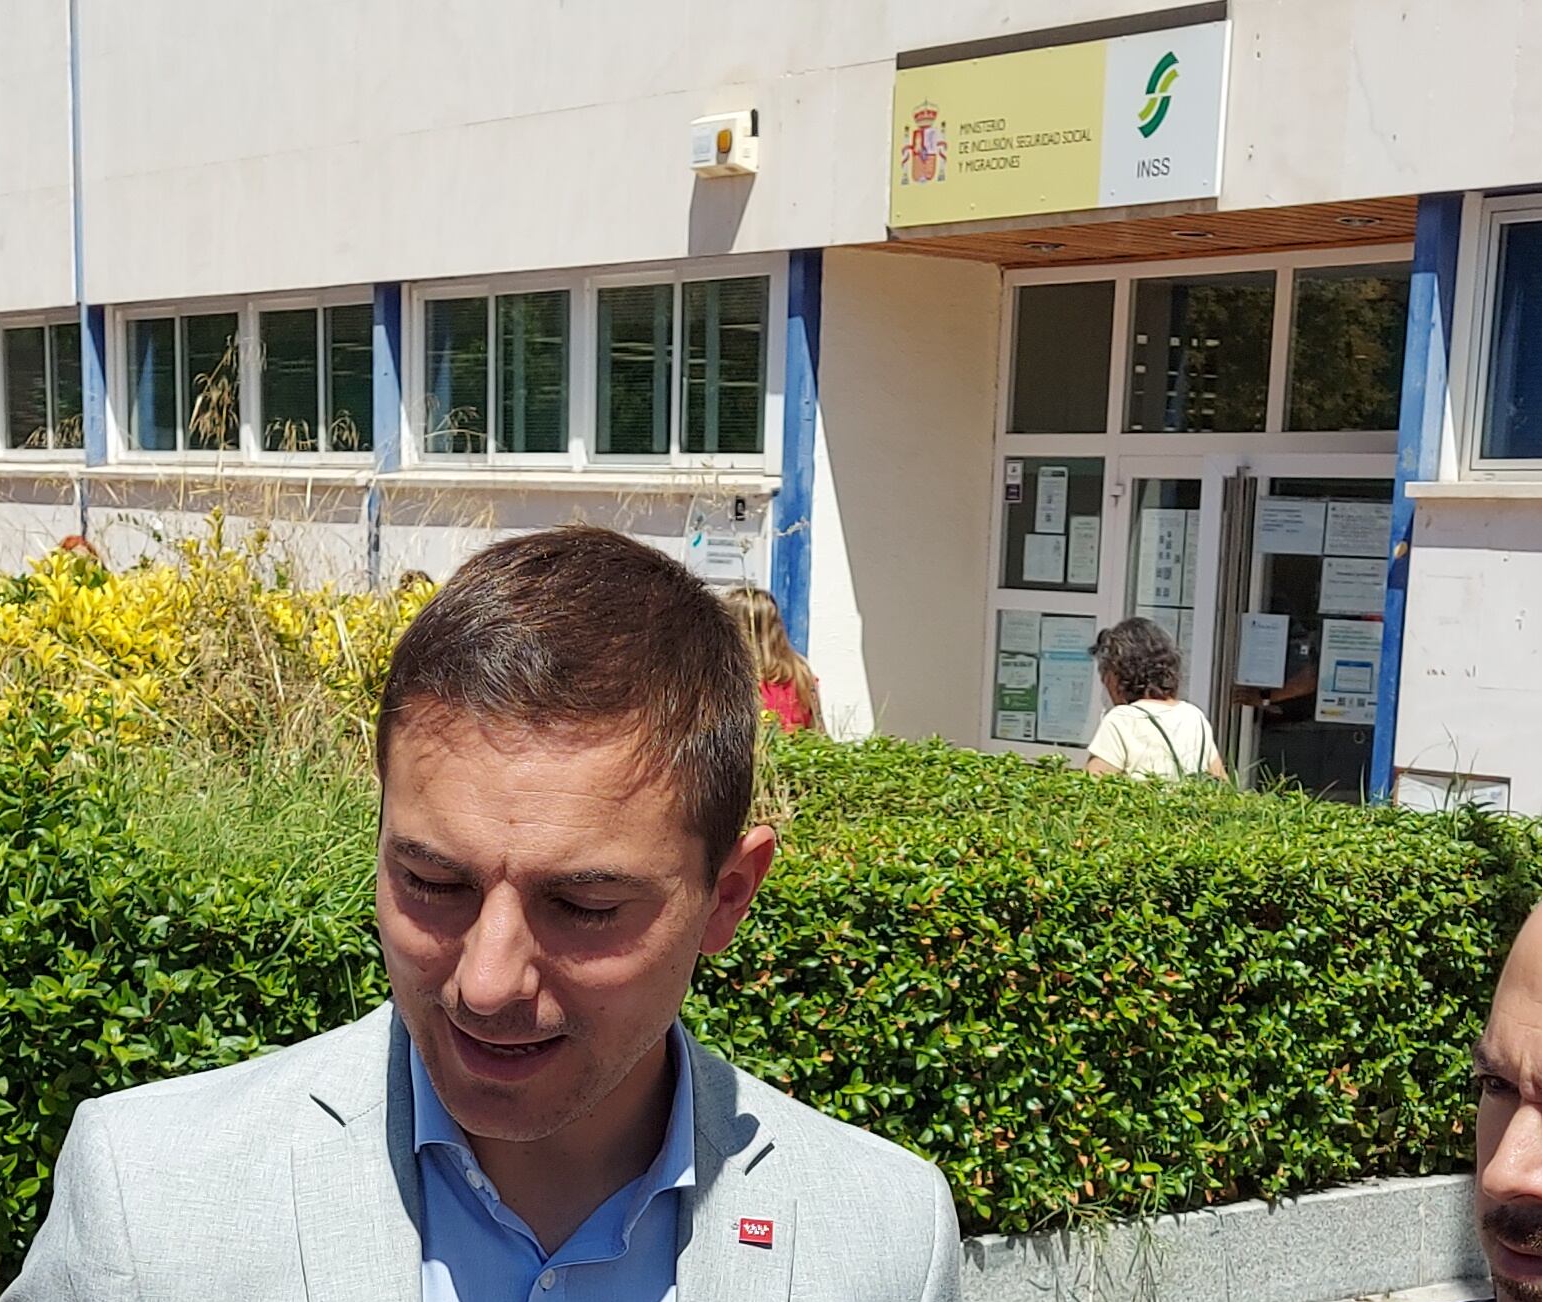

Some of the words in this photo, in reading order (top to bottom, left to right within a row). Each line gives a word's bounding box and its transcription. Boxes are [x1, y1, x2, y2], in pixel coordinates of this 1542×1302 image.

[959, 118, 1006, 136] MINISTERIO
[958, 141, 969, 154] DE
[1016, 132, 1060, 148] SEGURIDAD
[1062, 128, 1093, 144] SOCIAL
[958, 161, 964, 173] Y
[965, 155, 1021, 172] MIGRACIONES
[1136, 157, 1171, 179] INSS
